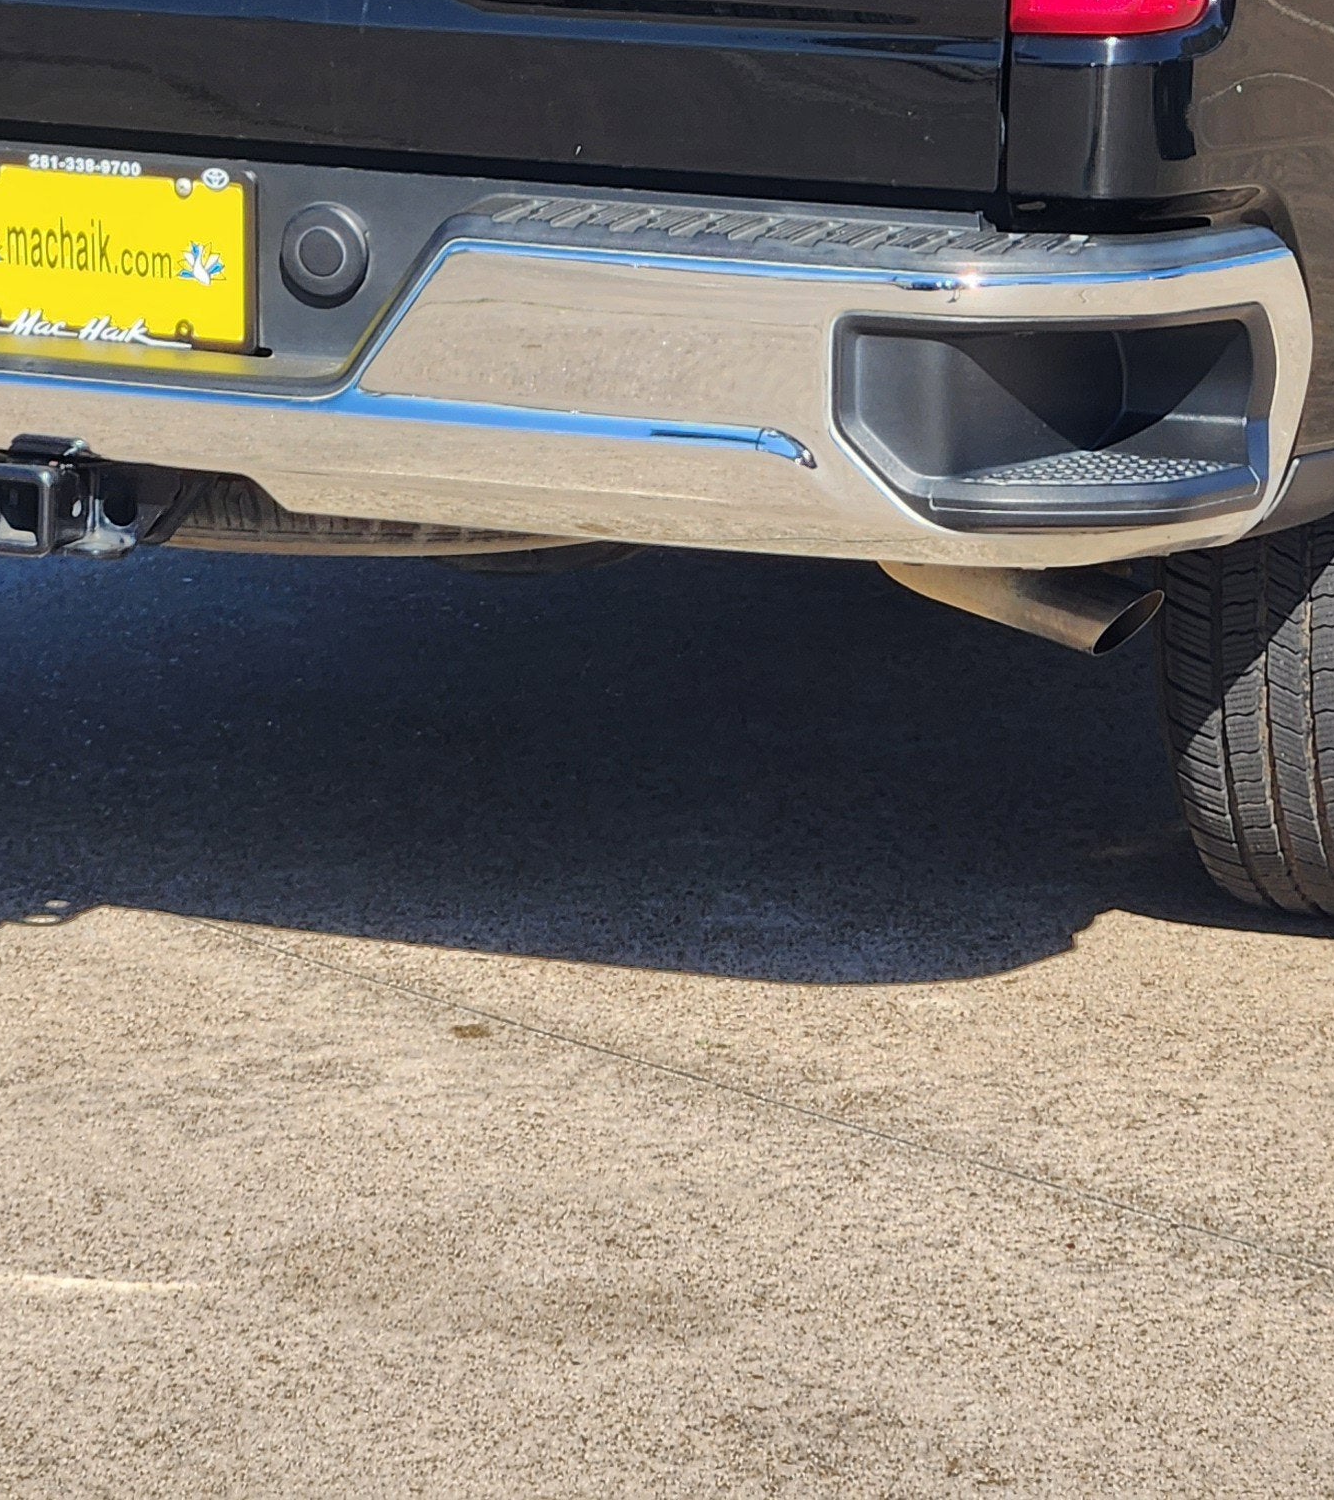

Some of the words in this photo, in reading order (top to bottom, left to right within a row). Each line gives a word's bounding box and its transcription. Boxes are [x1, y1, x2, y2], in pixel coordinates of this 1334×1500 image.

[28, 153, 143, 177] 281-338-9700
[7, 216, 172, 279] machaik.com
[0, 308, 78, 337] Mac
[77, 315, 180, 349] Haik
